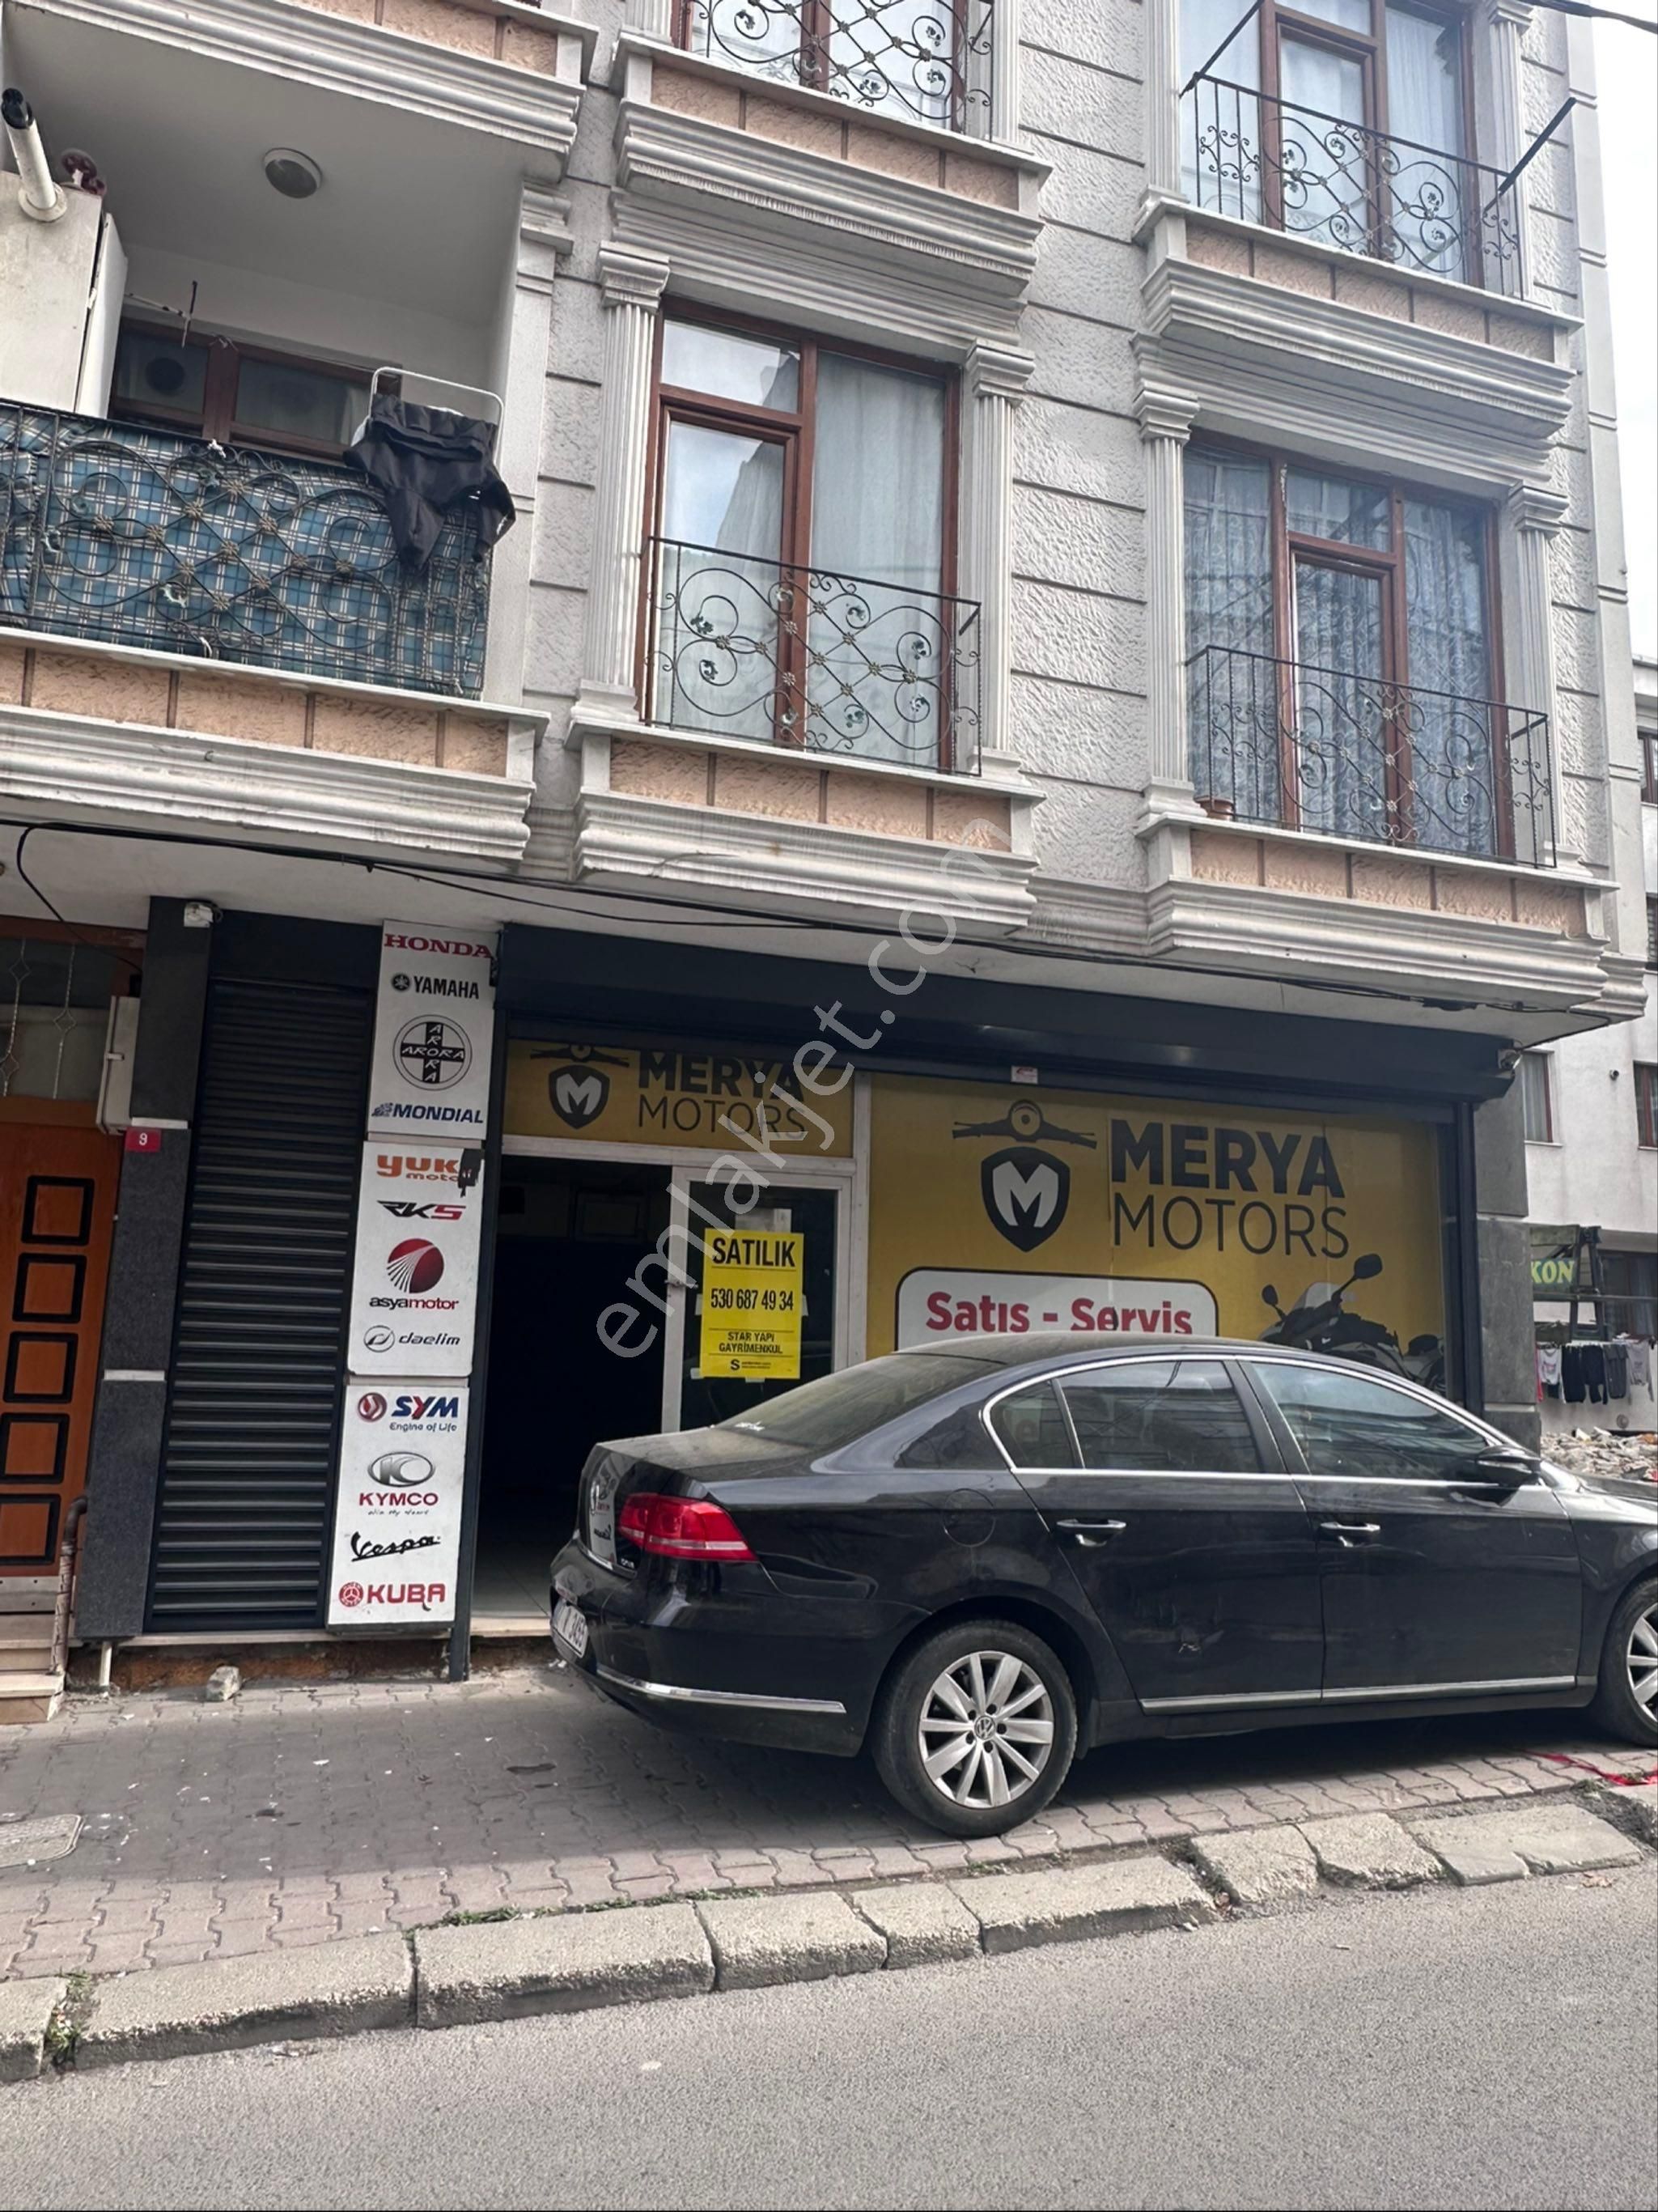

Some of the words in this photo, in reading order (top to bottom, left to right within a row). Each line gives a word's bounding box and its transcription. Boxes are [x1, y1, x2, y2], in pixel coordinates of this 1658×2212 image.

[384, 933, 493, 958] HONDA
[413, 975, 479, 1000] YAMAHA
[638, 1051, 804, 1102] MERYA
[392, 1103, 484, 1123] MONDIAL
[638, 1094, 808, 1139] MOTORS
[138, 1132, 148, 1146] 9
[376, 1154, 460, 1178] yuk
[1111, 1118, 1346, 1199] MERYA
[1113, 1193, 1350, 1259] MOTORS
[712, 1238, 796, 1267] SATILIK
[369, 1297, 460, 1310] asyamotor
[710, 1288, 733, 1310] 530
[736, 1289, 759, 1310] 687
[761, 1289, 776, 1311] 49
[779, 1290, 794, 1311] 34
[1070, 1297, 1194, 1335] Servis
[398, 1332, 460, 1346] daelim
[727, 1331, 752, 1341] STAR
[391, 1396, 459, 1420] SYM
[389, 1422, 423, 1432] Engine
[426, 1423, 437, 1433] of
[439, 1423, 457, 1433] Life
[358, 1492, 439, 1506] KYMCO
[351, 1531, 441, 1562] Vespa
[367, 1583, 446, 1604] KUBA
